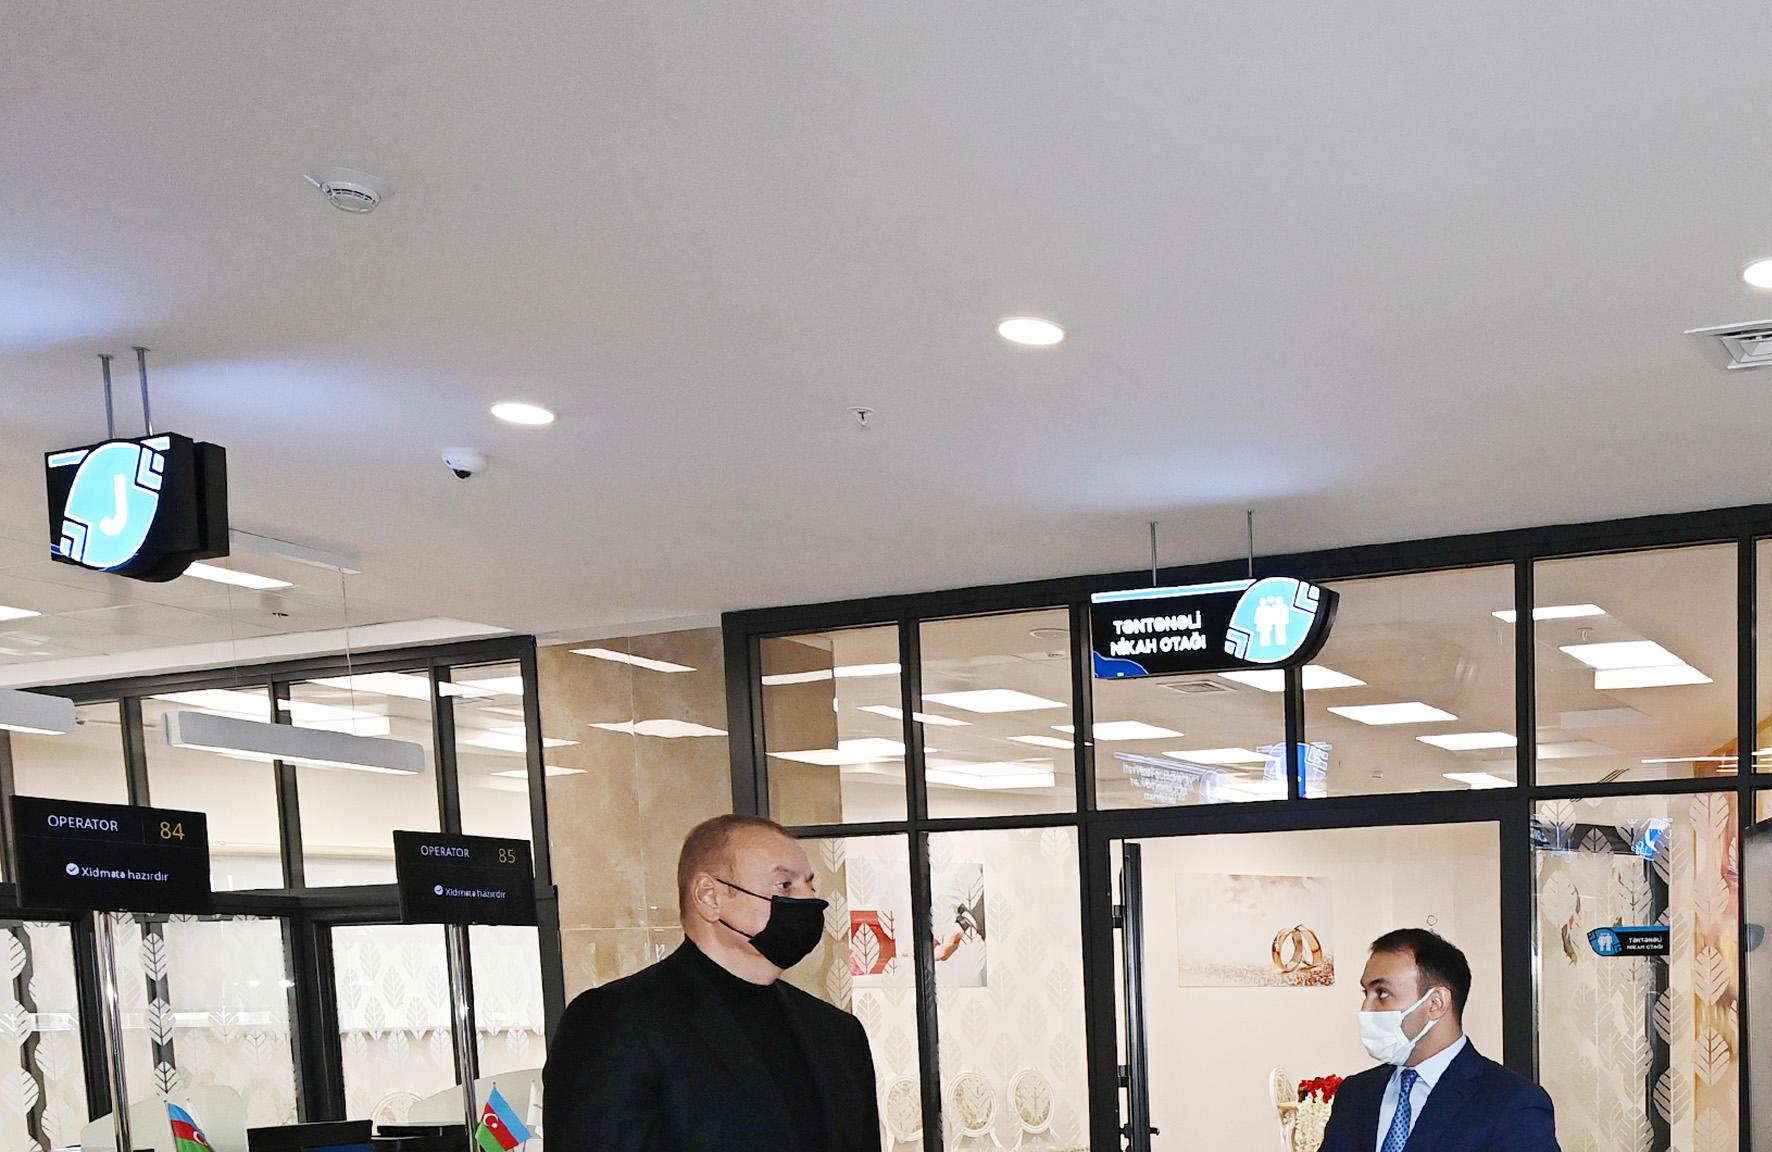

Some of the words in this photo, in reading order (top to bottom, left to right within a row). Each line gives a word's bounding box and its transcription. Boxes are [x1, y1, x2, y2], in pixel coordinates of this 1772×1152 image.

[98, 473, 129, 537] J
[1112, 609, 1202, 636] TƏNTƏNƏLİ
[1109, 635, 1157, 657] NİKAH
[1160, 632, 1207, 653] OTAĞI
[47, 814, 119, 832] OPERATOR
[159, 821, 186, 841] 84
[420, 844, 471, 858] OPERATOR
[498, 848, 516, 864] 85
